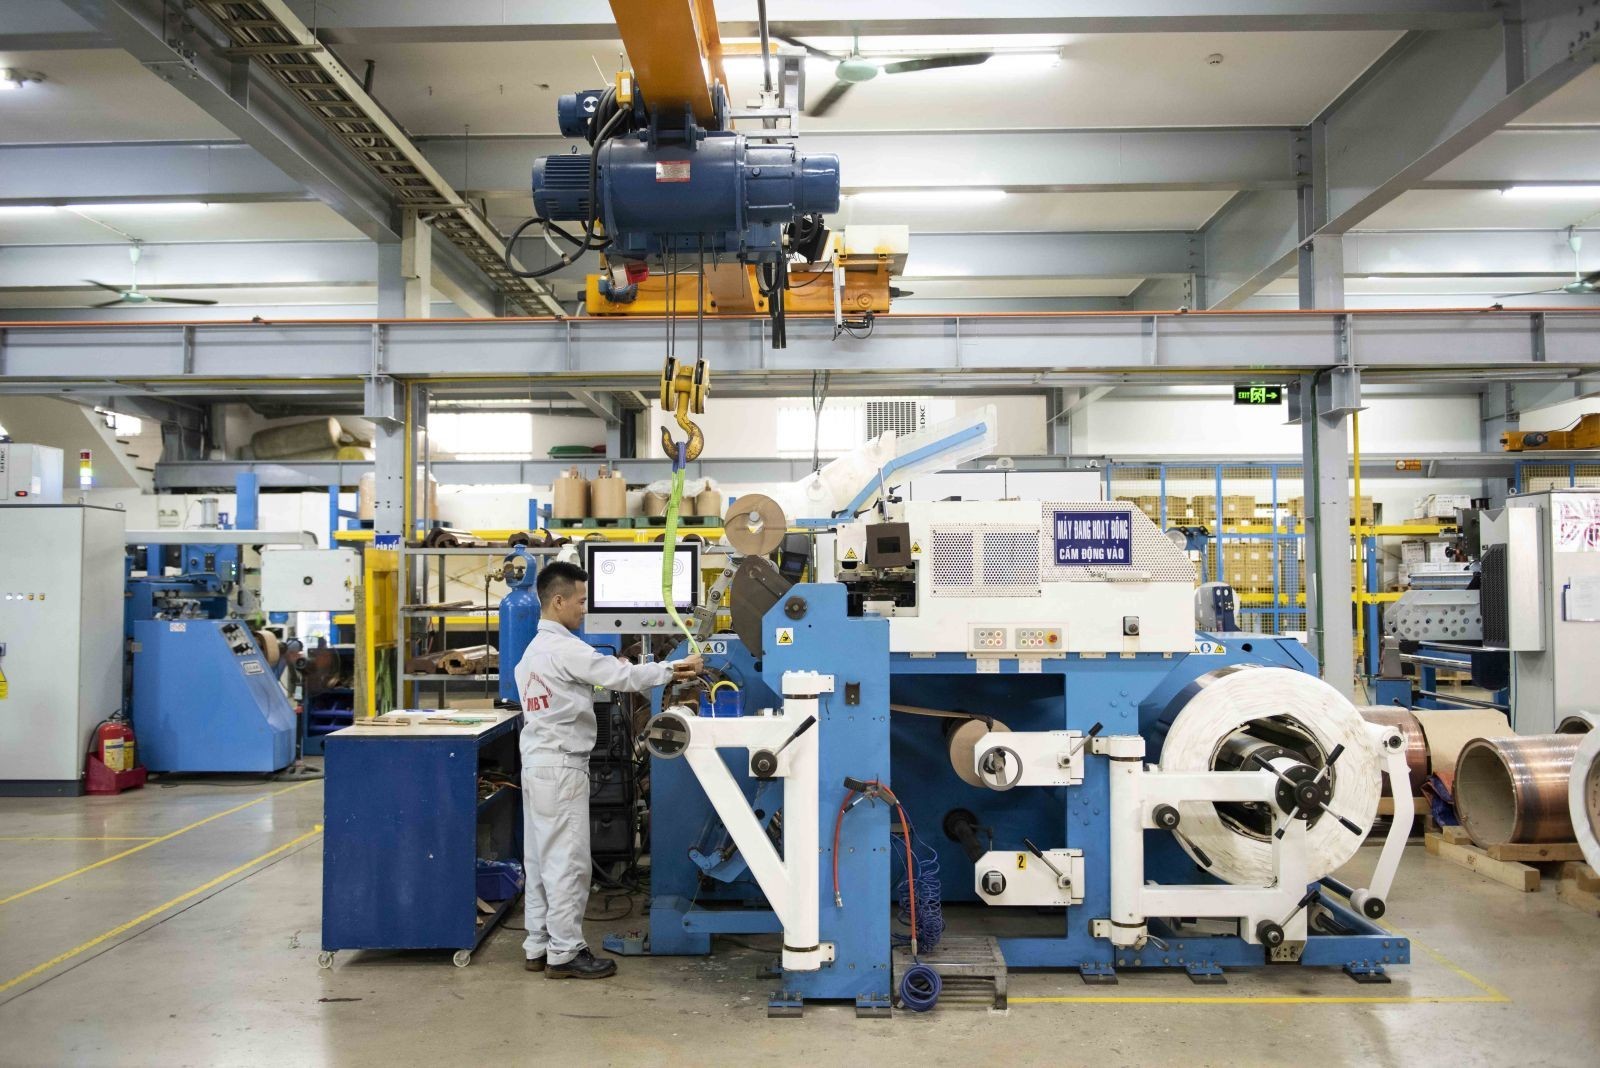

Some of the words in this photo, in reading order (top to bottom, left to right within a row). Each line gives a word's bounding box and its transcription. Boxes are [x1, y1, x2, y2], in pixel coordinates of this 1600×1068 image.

[1238, 391, 1250, 399] EXIT
[1057, 515, 1073, 540] MÁY
[1074, 519, 1092, 540] ĐANG
[1092, 519, 1110, 545] HOẠT
[1110, 515, 1129, 545] ĐỘNG
[1059, 544, 1079, 560] CẤM
[1081, 545, 1105, 563] ĐỘNG
[1106, 545, 1125, 560] VÀO
[1018, 855, 1025, 869] 2
